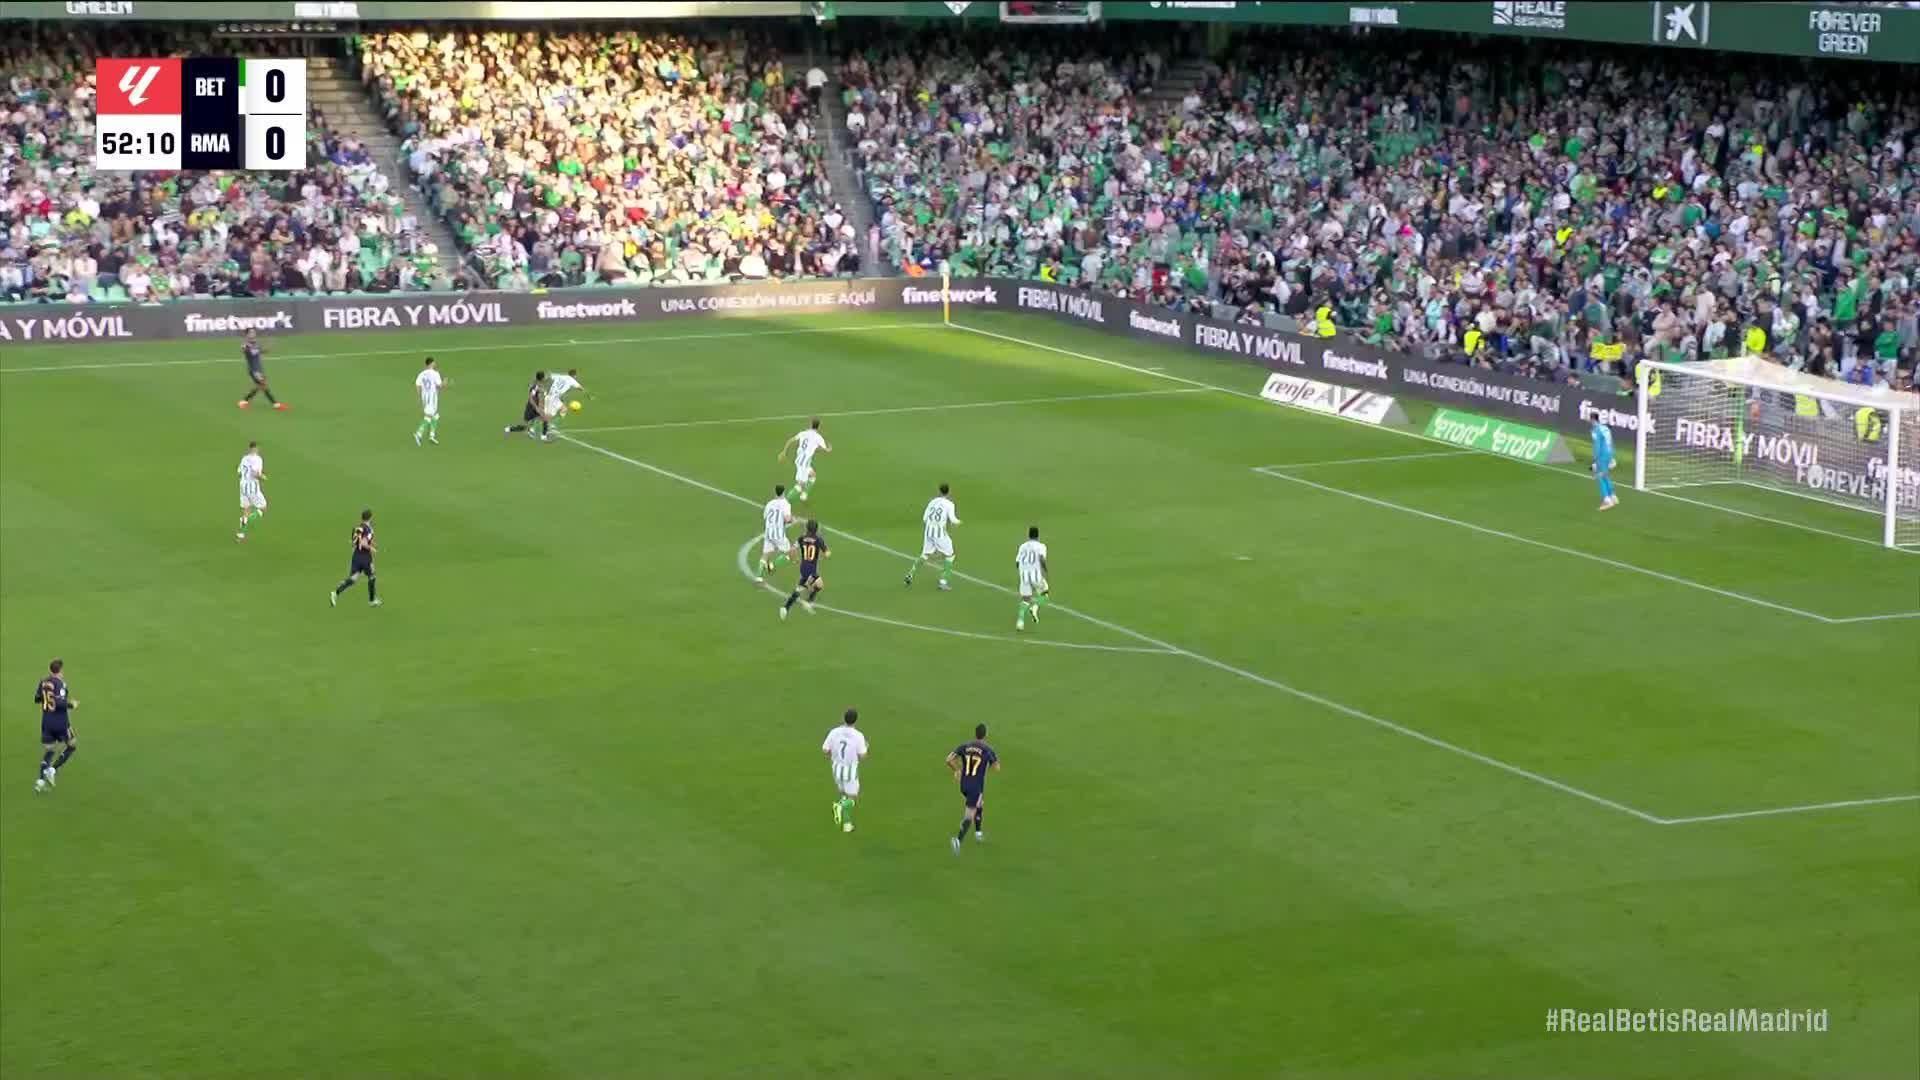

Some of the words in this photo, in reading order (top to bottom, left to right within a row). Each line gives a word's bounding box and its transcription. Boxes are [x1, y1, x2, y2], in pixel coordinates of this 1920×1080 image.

[1809, 9, 1881, 32] FOREVER
[1819, 33, 1868, 54] GREEN
[537, 299, 636, 319] finetwork
[661, 299, 696, 312] UNA
[838, 288, 875, 306] AQUÍ
[1018, 287, 1058, 310] FIBRA
[1056, 293, 1068, 312] Y
[1067, 293, 1104, 322] MÓVIL
[184, 311, 293, 332] finetwork
[323, 306, 400, 328] FIBRA
[404, 305, 423, 325] Y
[429, 299, 508, 324] MÓVIL
[1129, 310, 1181, 338] finetwork
[16, 319, 36, 340] Y
[44, 311, 133, 338] MÓVIL
[1195, 324, 1240, 352] FIBRA
[1239, 334, 1254, 354] Y
[1255, 333, 1305, 365] MÓVIL
[1323, 350, 1388, 379] finetwork
[1267, 379, 1315, 402] renfe
[1403, 368, 1428, 386] UNA
[1430, 371, 1483, 397] CONEXIÓN
[1485, 383, 1512, 402] MUY
[1513, 389, 1530, 405] DE
[1531, 391, 1560, 414] AQUÍ
[1675, 419, 1734, 453] FIBRA
[768, 508, 780, 523] 21
[929, 506, 943, 522] 28
[803, 544, 816, 561] 10
[1019, 550, 1036, 565] 20
[43, 690, 56, 711] 15
[839, 740, 848, 759] 7
[965, 755, 981, 776] 17
